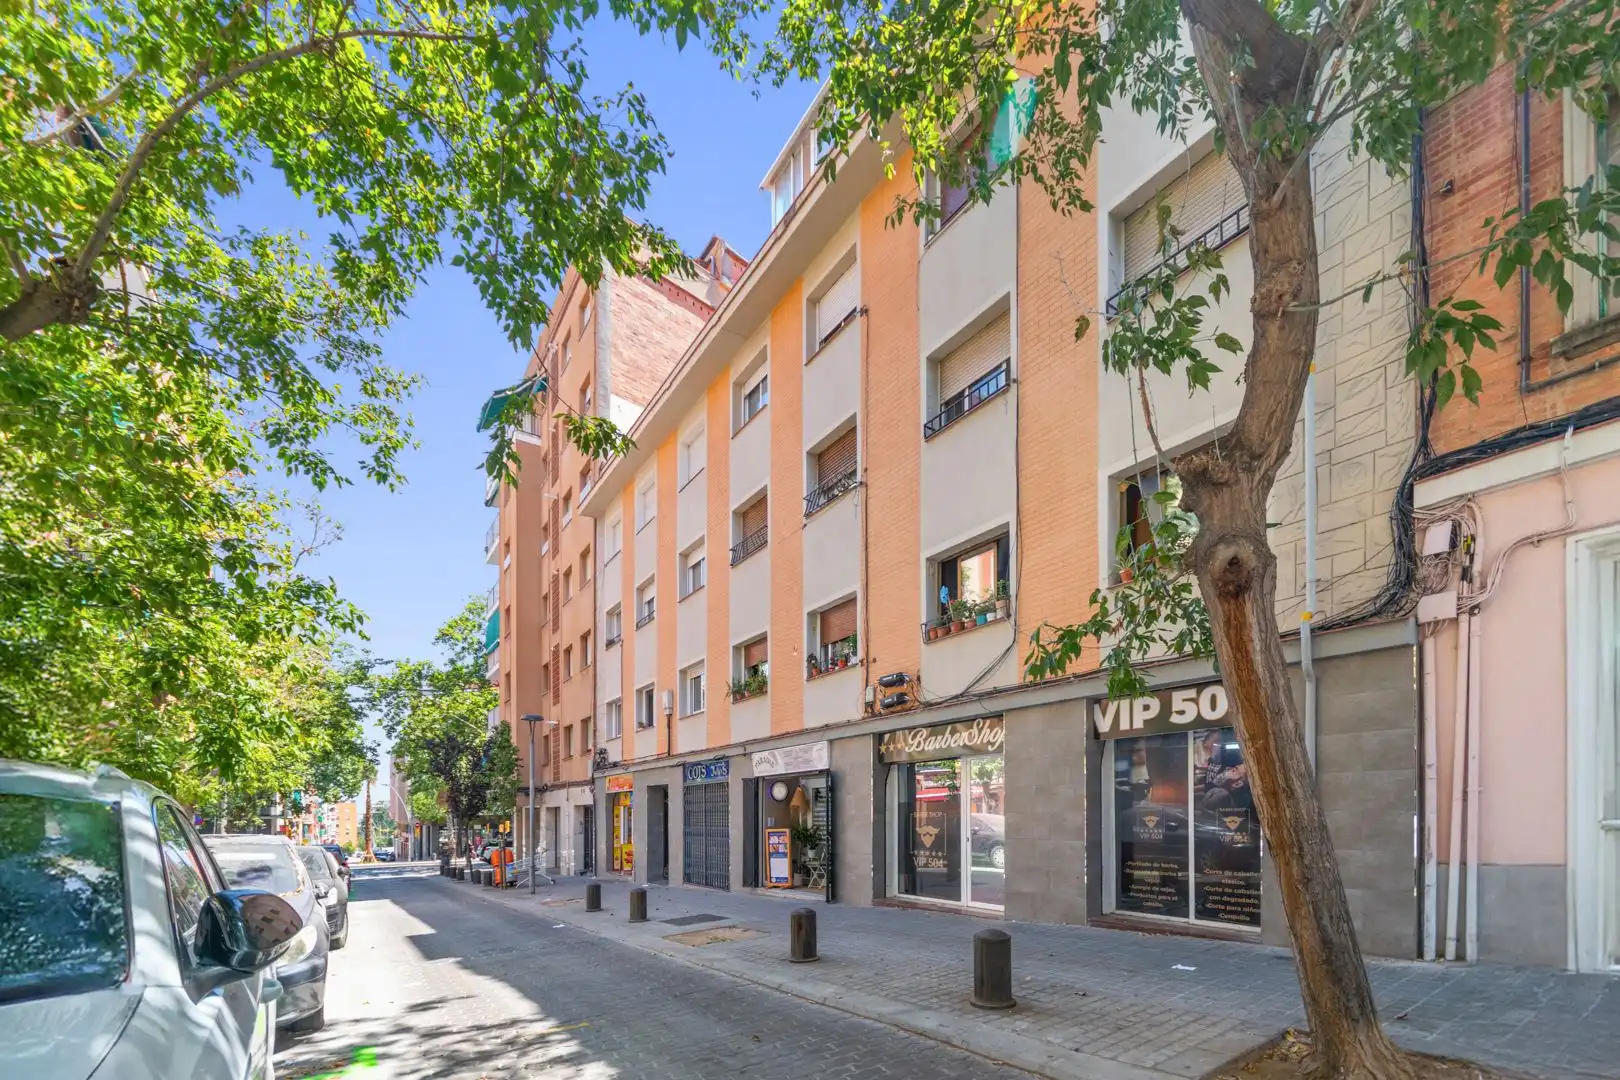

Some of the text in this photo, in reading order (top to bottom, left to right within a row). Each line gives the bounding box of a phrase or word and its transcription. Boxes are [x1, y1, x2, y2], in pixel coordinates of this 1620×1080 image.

[1094, 685, 1229, 733] VIP 50
[913, 856, 927, 867] VIP
